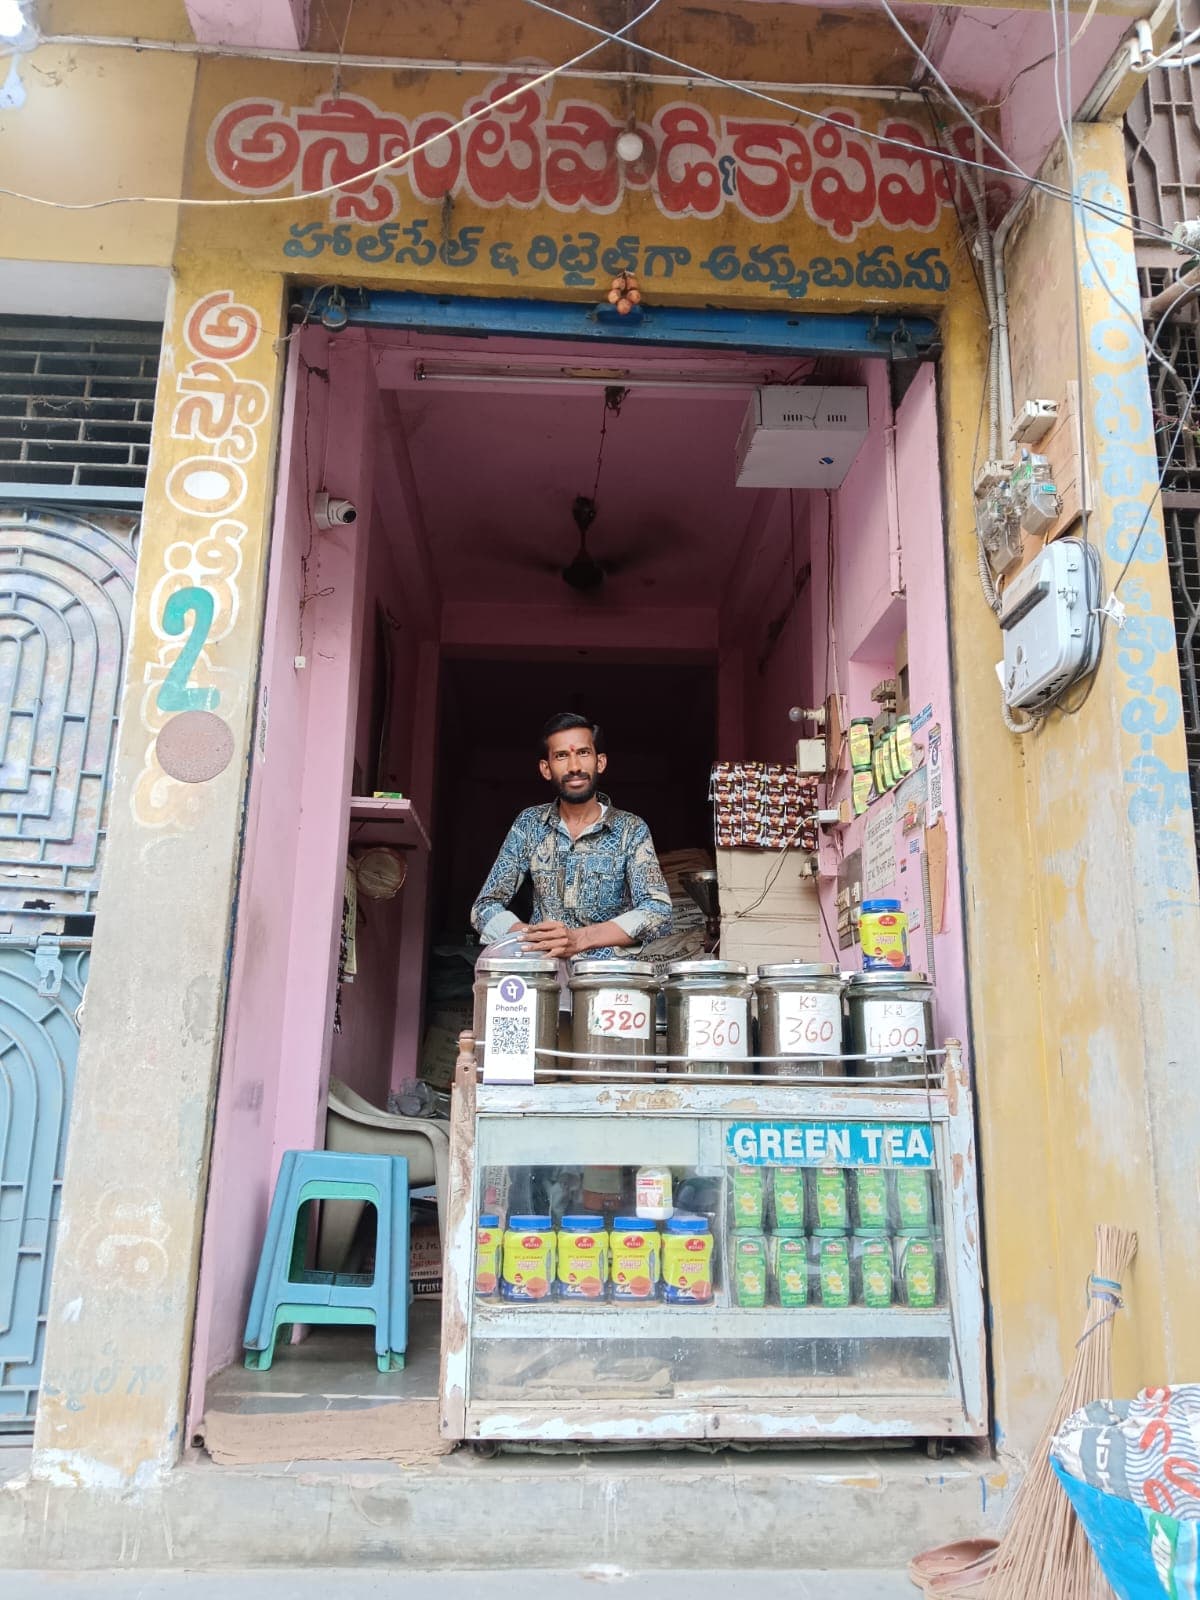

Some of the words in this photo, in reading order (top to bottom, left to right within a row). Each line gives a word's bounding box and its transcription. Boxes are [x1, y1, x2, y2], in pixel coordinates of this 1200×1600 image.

[157, 586, 222, 712] 2
[495, 1004, 528, 1013] PhonePe
[600, 1009, 647, 1032] 320
[693, 1018, 741, 1047] 360
[786, 1017, 834, 1046] 360
[733, 1127, 850, 1159] GREEN
[860, 1129, 930, 1159] TEA
